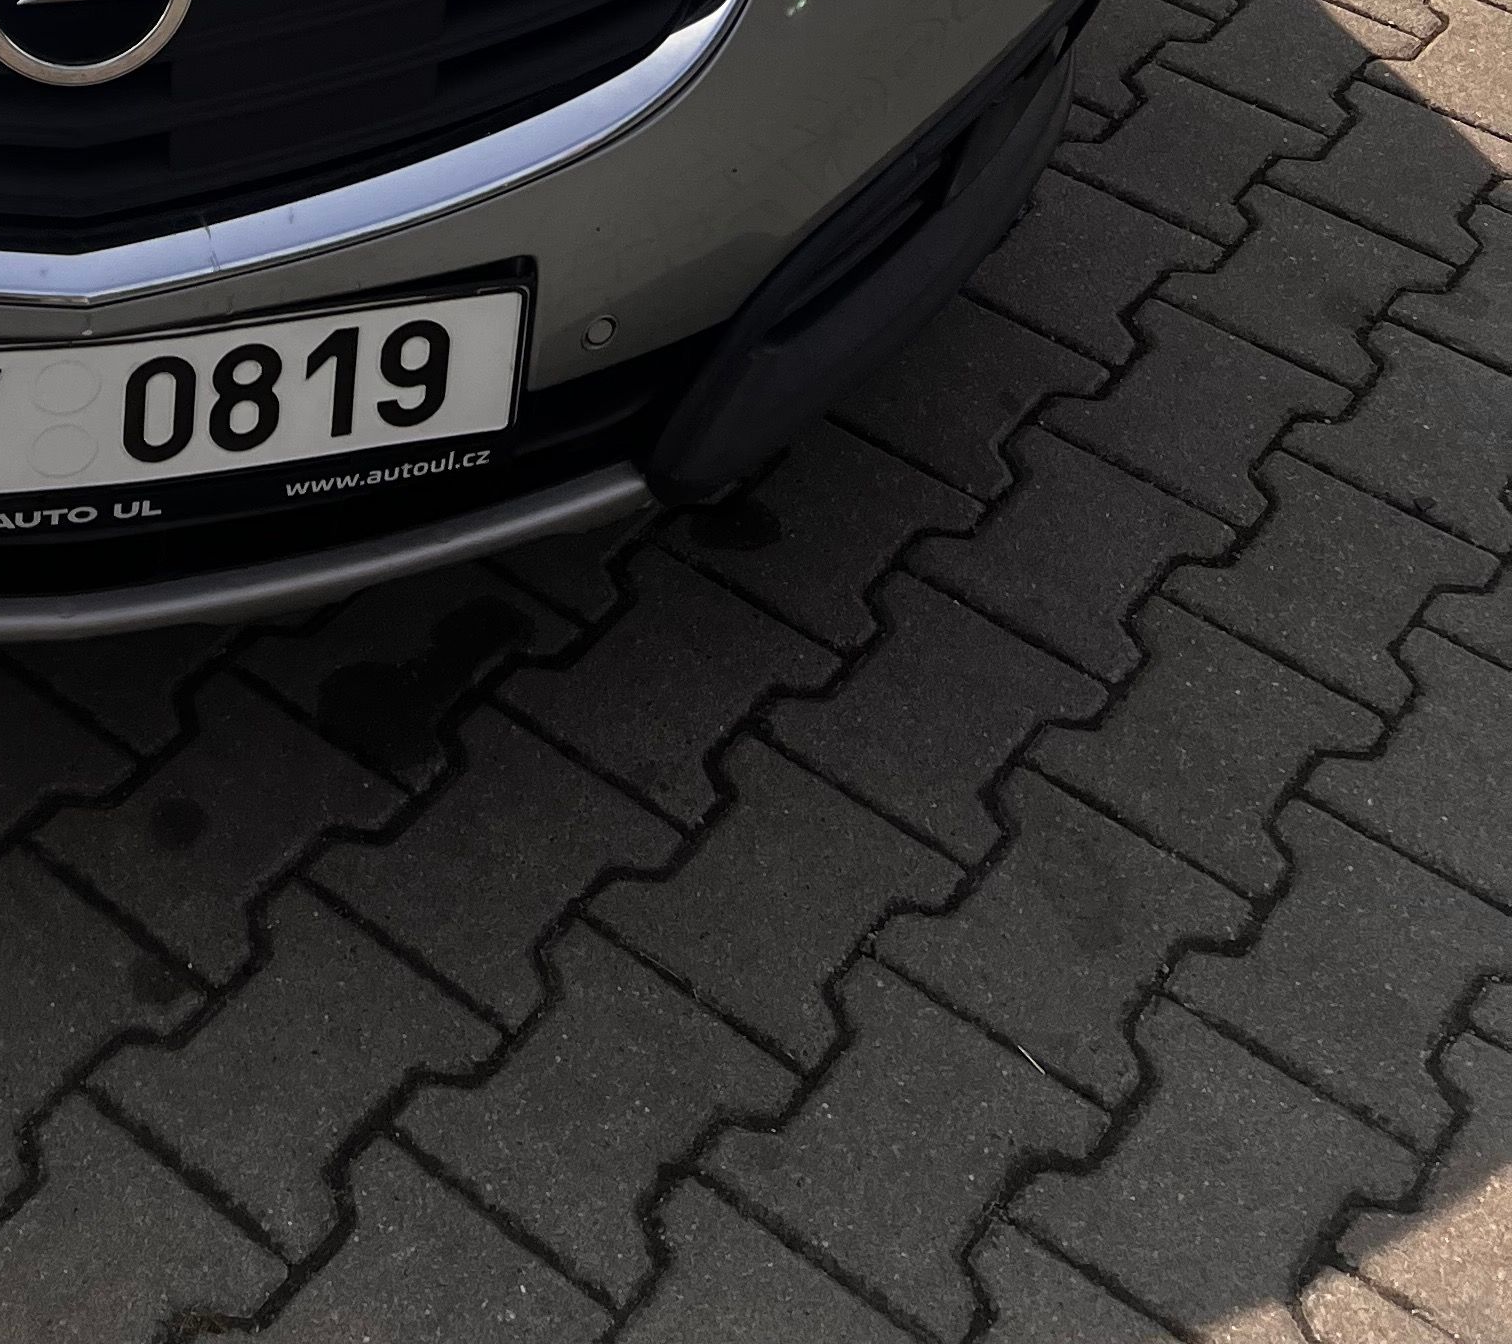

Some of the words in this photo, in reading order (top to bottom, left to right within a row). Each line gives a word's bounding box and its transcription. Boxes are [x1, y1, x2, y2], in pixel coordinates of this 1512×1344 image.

[122, 320, 452, 464] 0819
[286, 449, 491, 497] www.autoul.cz
[113, 500, 162, 519] UL
